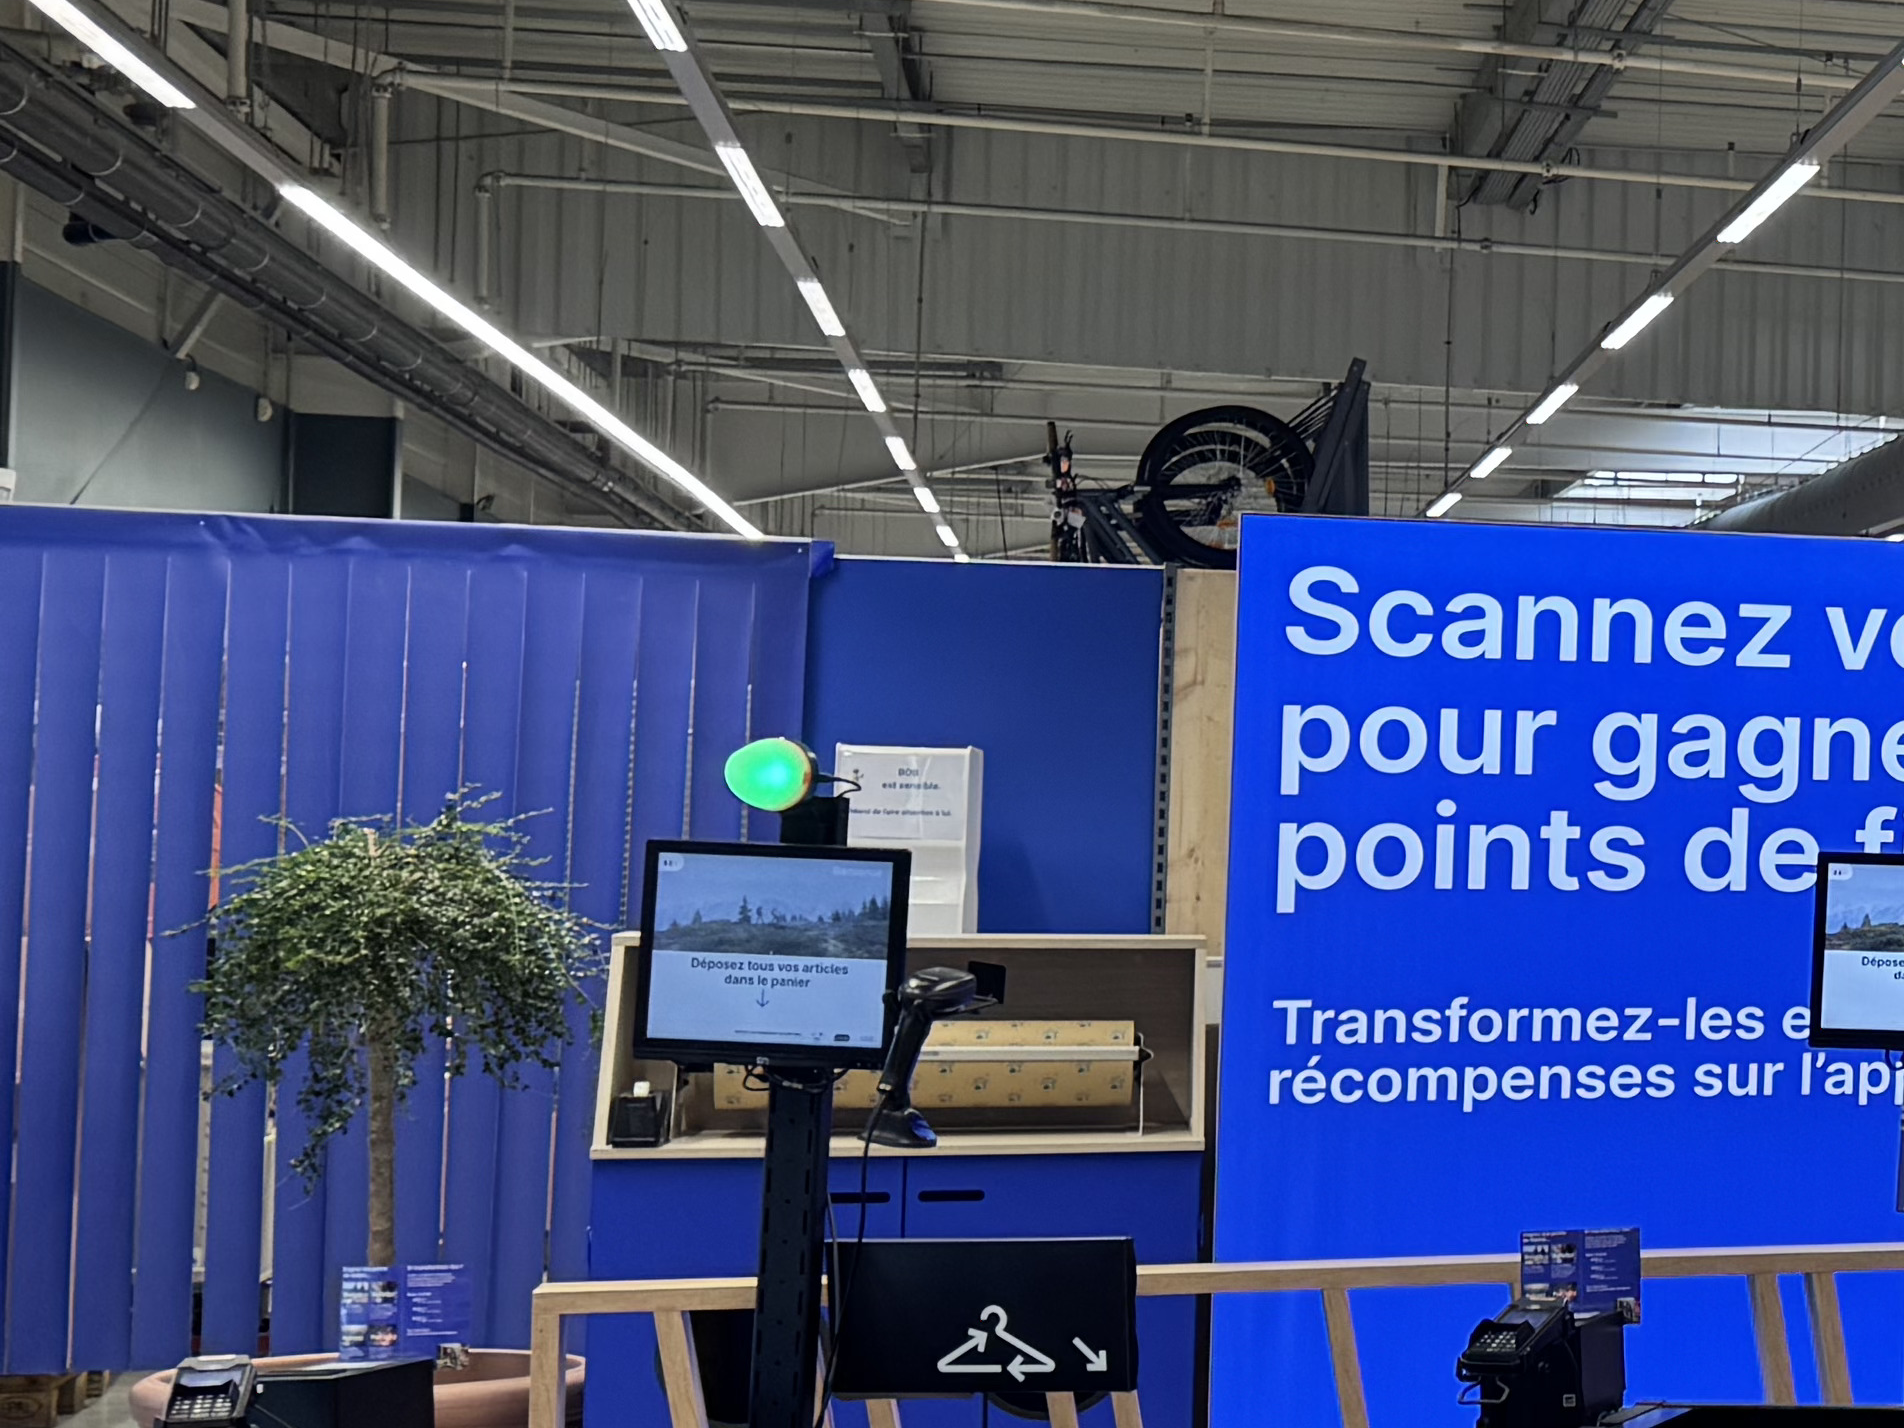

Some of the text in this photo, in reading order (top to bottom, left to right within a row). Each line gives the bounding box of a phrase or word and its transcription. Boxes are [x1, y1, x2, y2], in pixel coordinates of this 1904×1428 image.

[1285, 565, 1793, 669] Scannez
[1280, 704, 1557, 796] pour
[1276, 799, 1646, 914] points
[1684, 807, 1818, 893] de
[690, 957, 849, 975] Déposez tous vos articles
[724, 974, 811, 989] dans le panier
[1272, 996, 1765, 1046] Transformez-les
[1782, 1006, 1811, 1040] e
[1269, 1055, 1675, 1113] récompenses
[1693, 1061, 1785, 1097] sur
